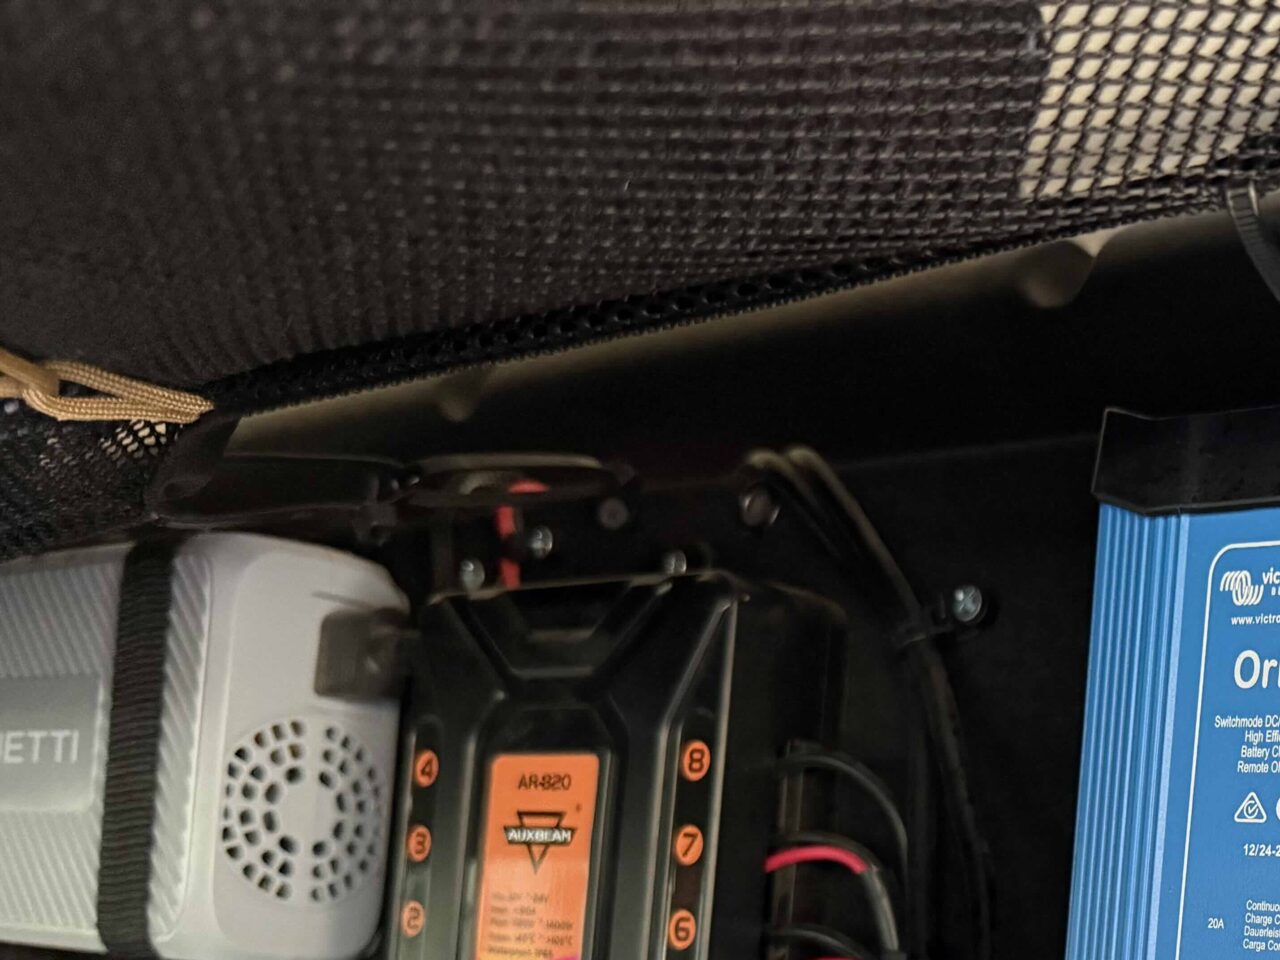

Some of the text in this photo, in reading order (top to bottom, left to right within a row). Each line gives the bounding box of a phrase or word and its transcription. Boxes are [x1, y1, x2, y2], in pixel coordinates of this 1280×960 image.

[1214, 714, 1263, 728] Switchmode
[1244, 730, 1263, 745] High
[0, 729, 79, 764] ETTI
[1241, 745, 1270, 760] Battery
[1237, 760, 1269, 774] Remote
[1207, 917, 1225, 929] 20A
[1245, 912, 1273, 926] Charge
[1242, 938, 1266, 952] Carga
